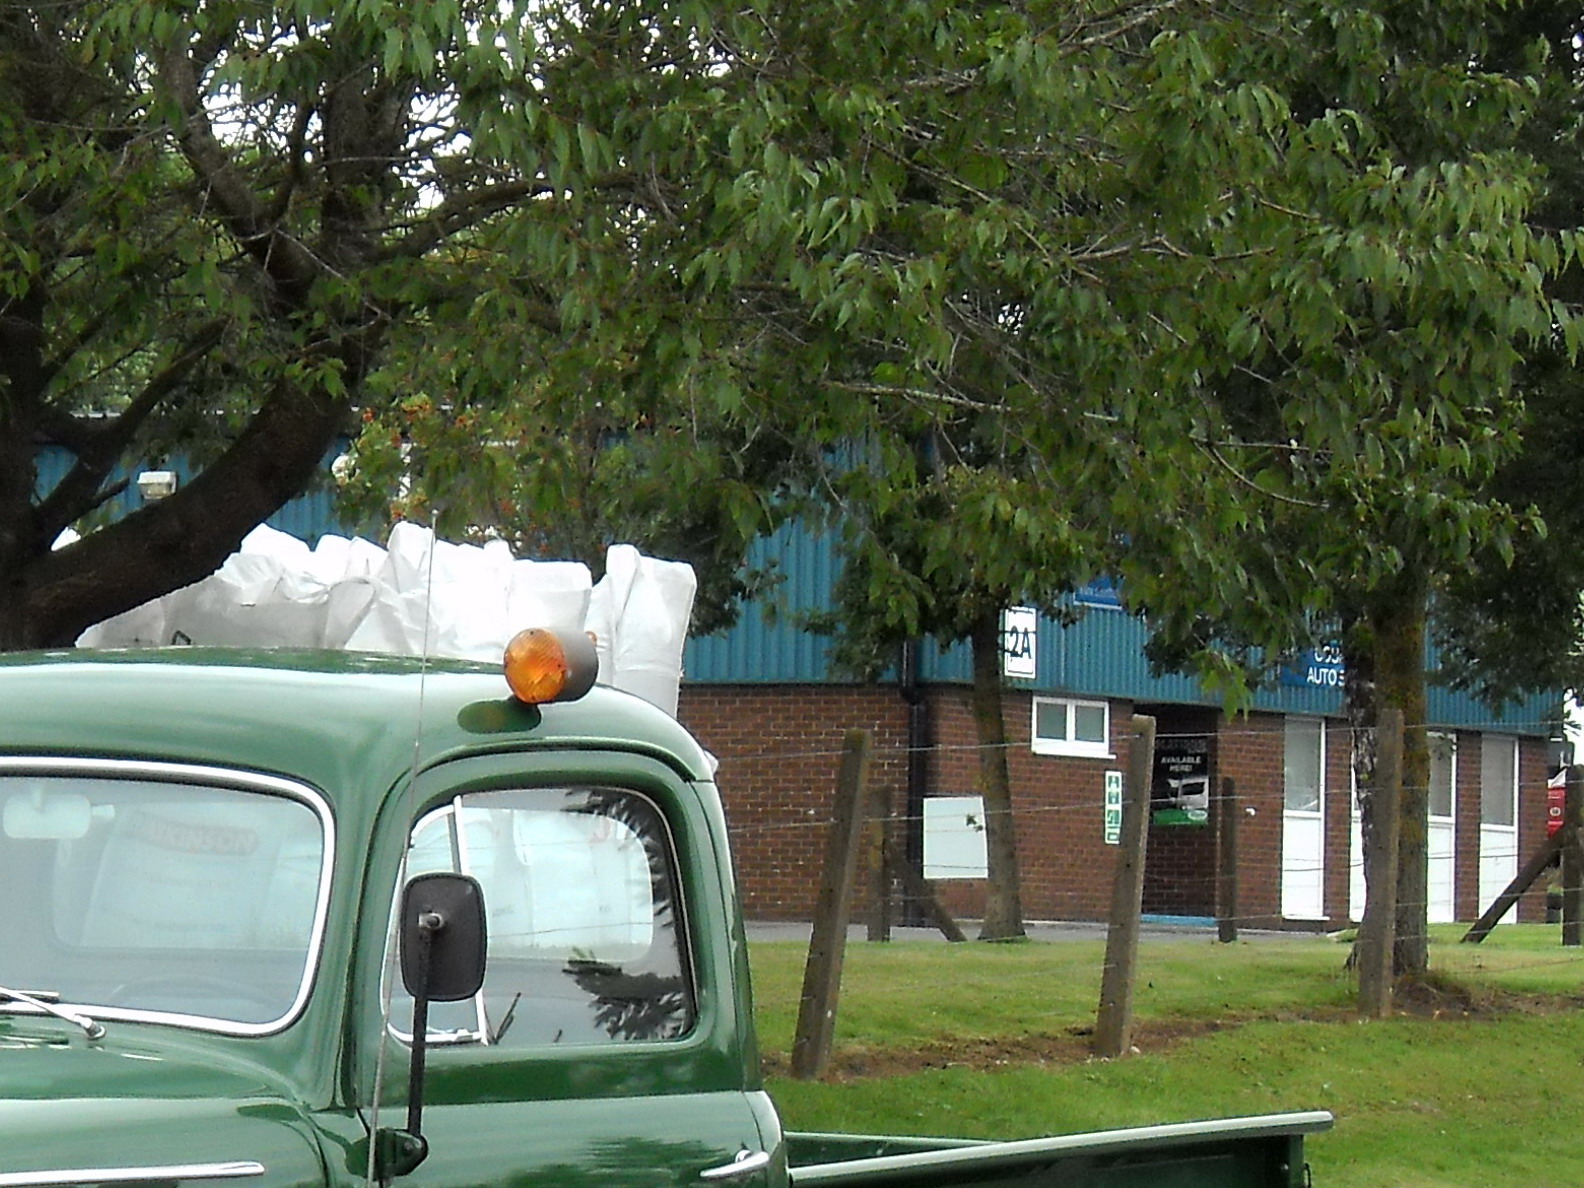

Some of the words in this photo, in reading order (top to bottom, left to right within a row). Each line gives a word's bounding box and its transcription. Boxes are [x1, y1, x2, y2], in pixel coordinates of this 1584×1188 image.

[1009, 625, 1032, 659] 2A
[1306, 666, 1337, 686] AUTO
[1160, 755, 1202, 764] AVAILABLE
